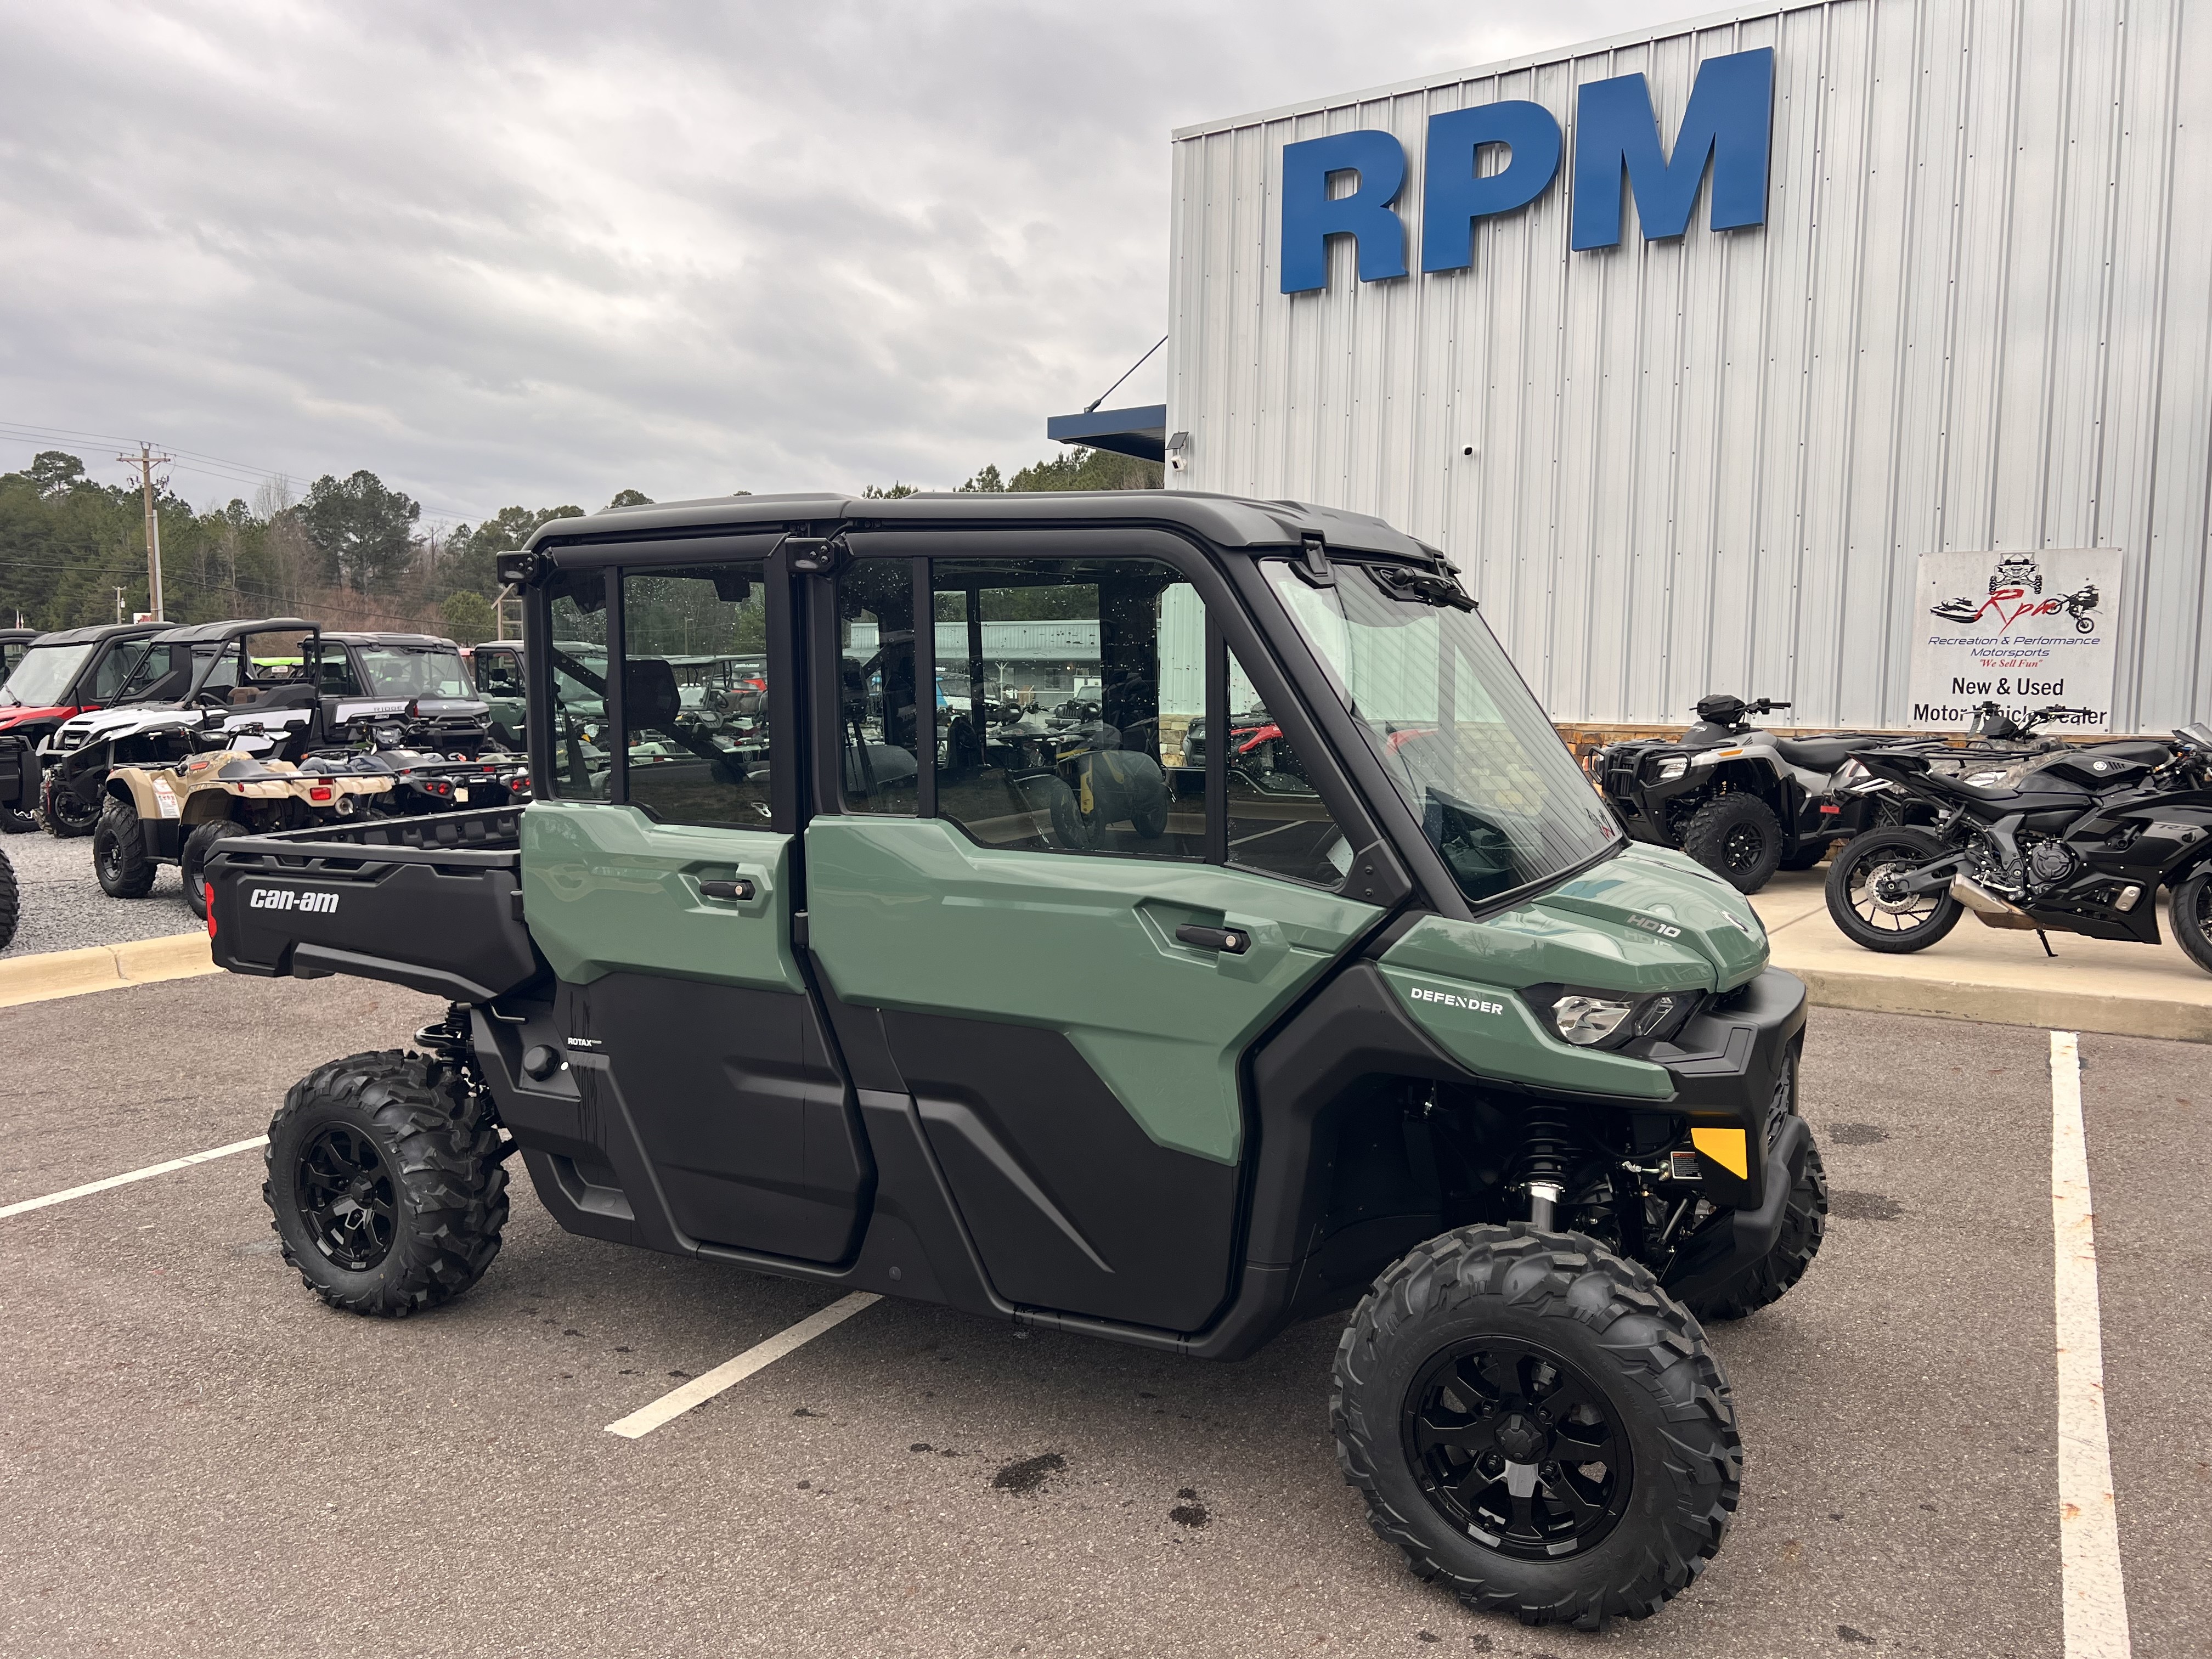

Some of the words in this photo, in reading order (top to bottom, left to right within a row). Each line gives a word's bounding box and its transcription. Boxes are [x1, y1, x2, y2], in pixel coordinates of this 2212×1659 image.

[1280, 46, 1774, 295] RPM
[1928, 636, 1997, 645] Recreation
[2001, 636, 2010, 645] &
[2014, 636, 2100, 645] Performance
[1971, 648, 2050, 657] Motorsports
[1952, 678, 1991, 695] New
[1996, 678, 2011, 696] &
[2017, 678, 2064, 696] Used
[1914, 704, 1967, 723] Motor
[250, 889, 340, 913] can-am
[1627, 915, 1681, 938] HD10
[1410, 988, 1504, 1015] DEFENDER
[567, 1037, 592, 1047] ROTAX
